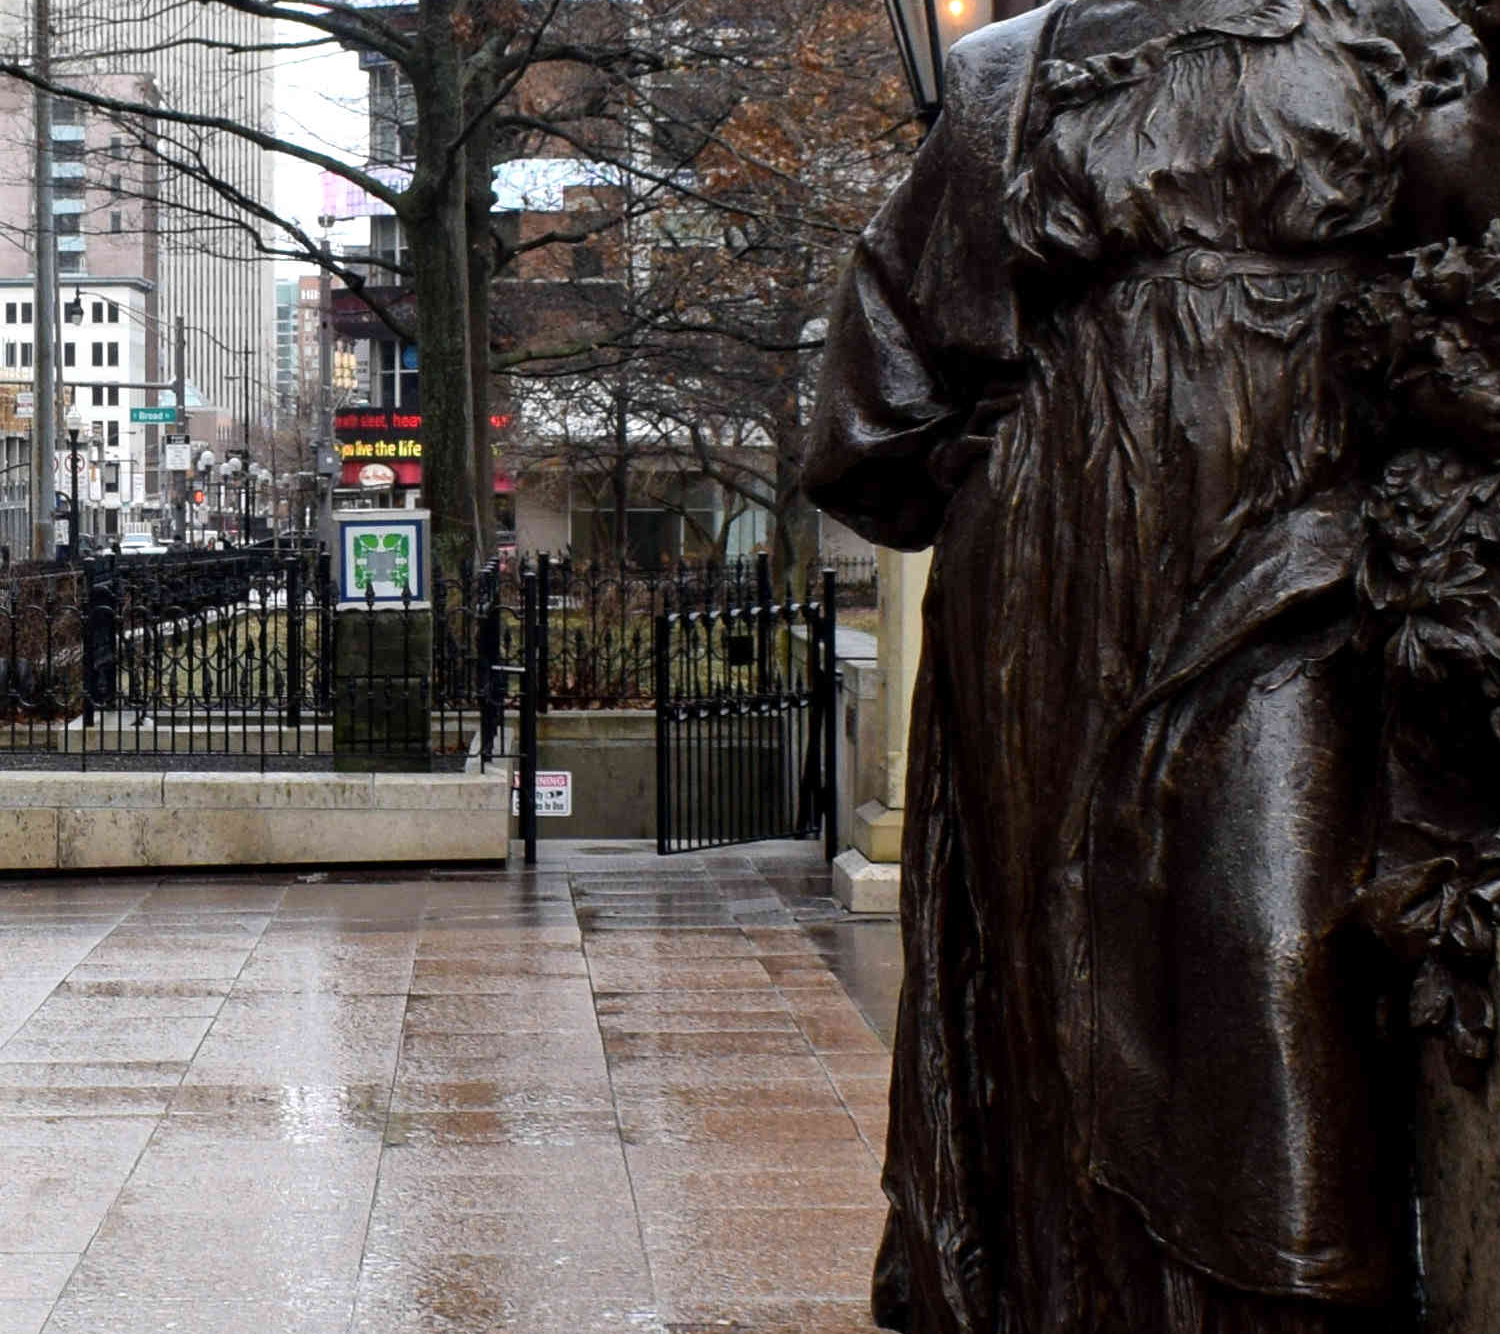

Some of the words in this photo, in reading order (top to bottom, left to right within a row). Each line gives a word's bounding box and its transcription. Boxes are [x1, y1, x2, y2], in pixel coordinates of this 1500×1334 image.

[139, 410, 164, 420] Broad
[374, 440, 397, 457] the
[398, 440, 423, 457] life
